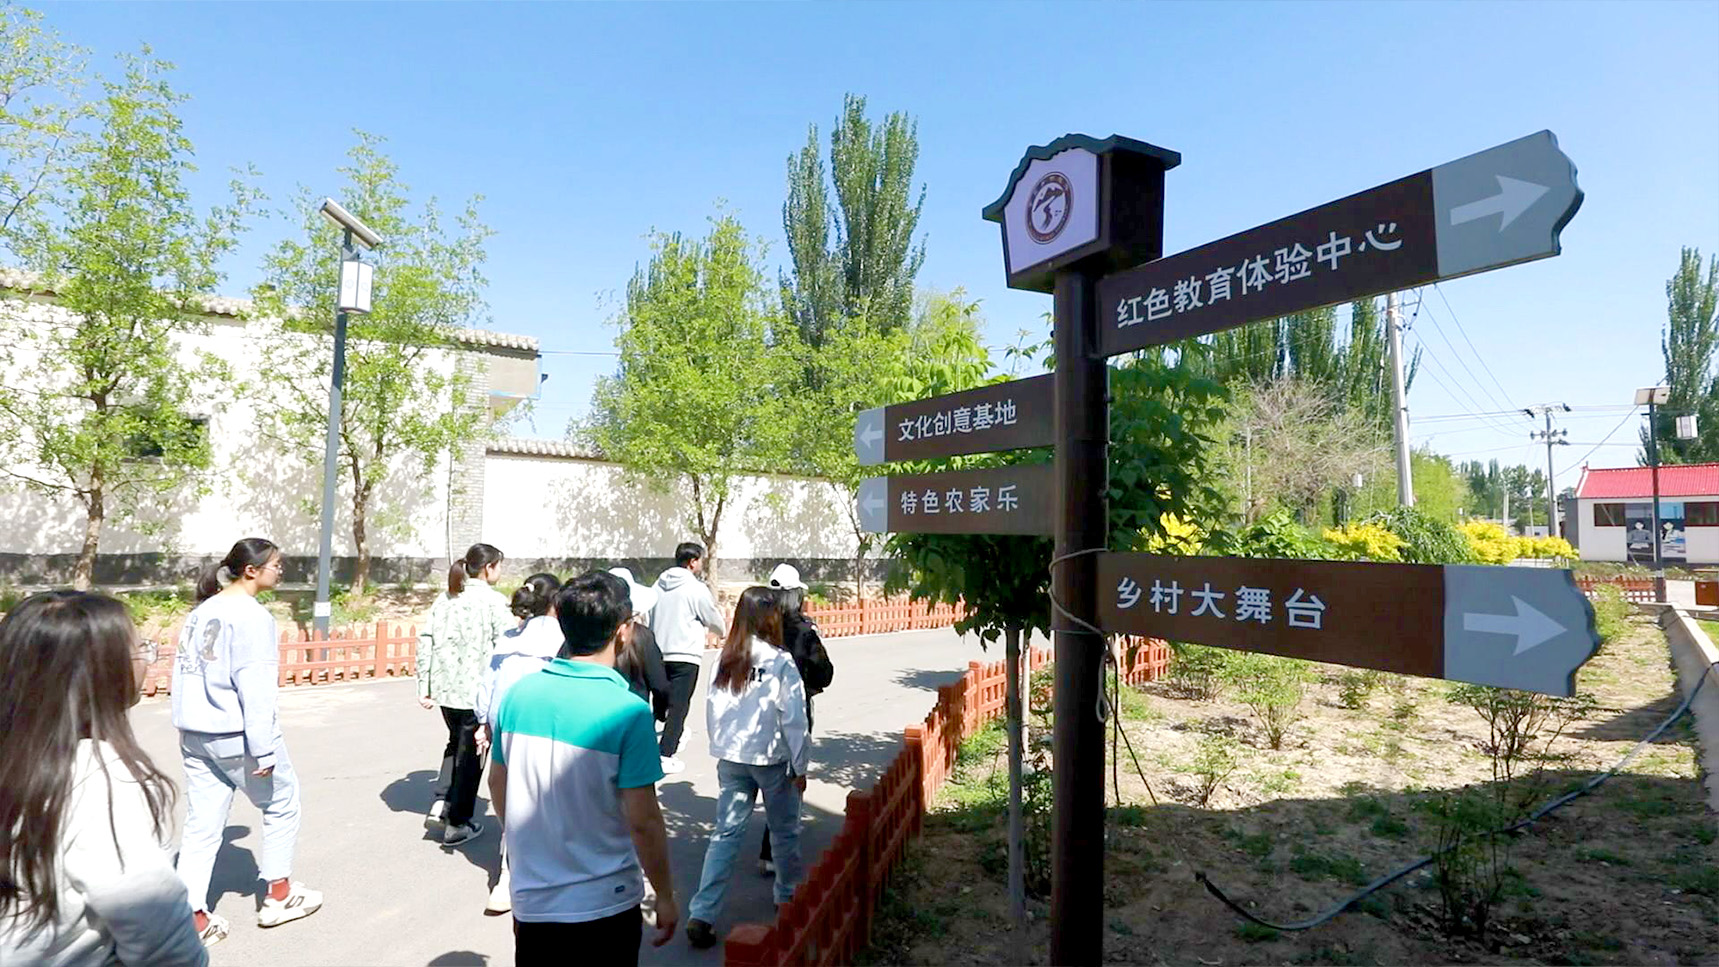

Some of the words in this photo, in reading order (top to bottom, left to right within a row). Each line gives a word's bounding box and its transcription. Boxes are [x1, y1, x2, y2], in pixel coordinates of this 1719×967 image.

[1116, 222, 1403, 329] 红色教育体验中心
[898, 398, 1018, 442] 文化创意基地
[900, 484, 1018, 515] 特色农家乐
[1116, 576, 1326, 629] 乡村大舞台
